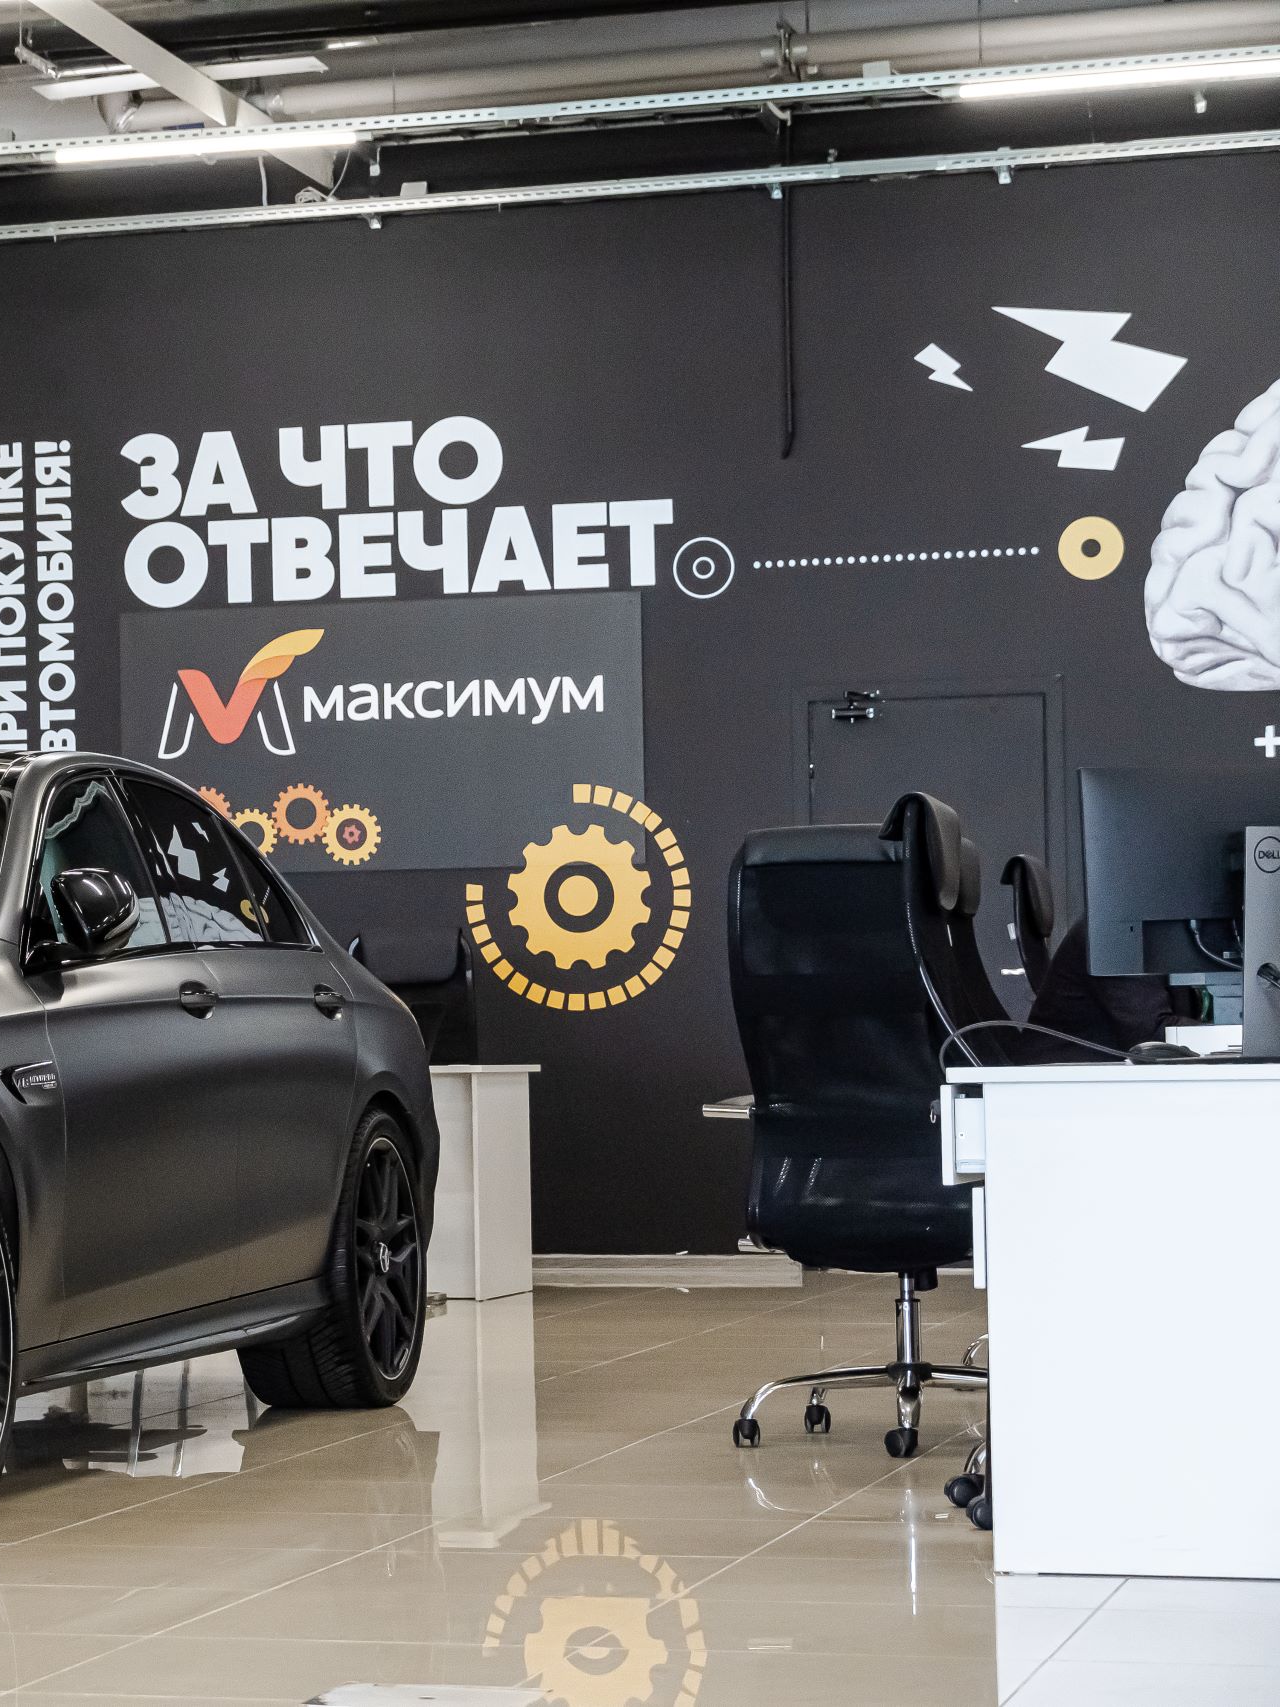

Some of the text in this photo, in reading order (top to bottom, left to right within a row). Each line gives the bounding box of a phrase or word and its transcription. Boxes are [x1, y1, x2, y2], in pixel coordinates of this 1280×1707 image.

[120, 415, 503, 520] ЗА ЧТО
[35, 439, 77, 751] ВТОМОБИЛЯ!
[123, 498, 674, 608] ОТВЕЧАЕТ
